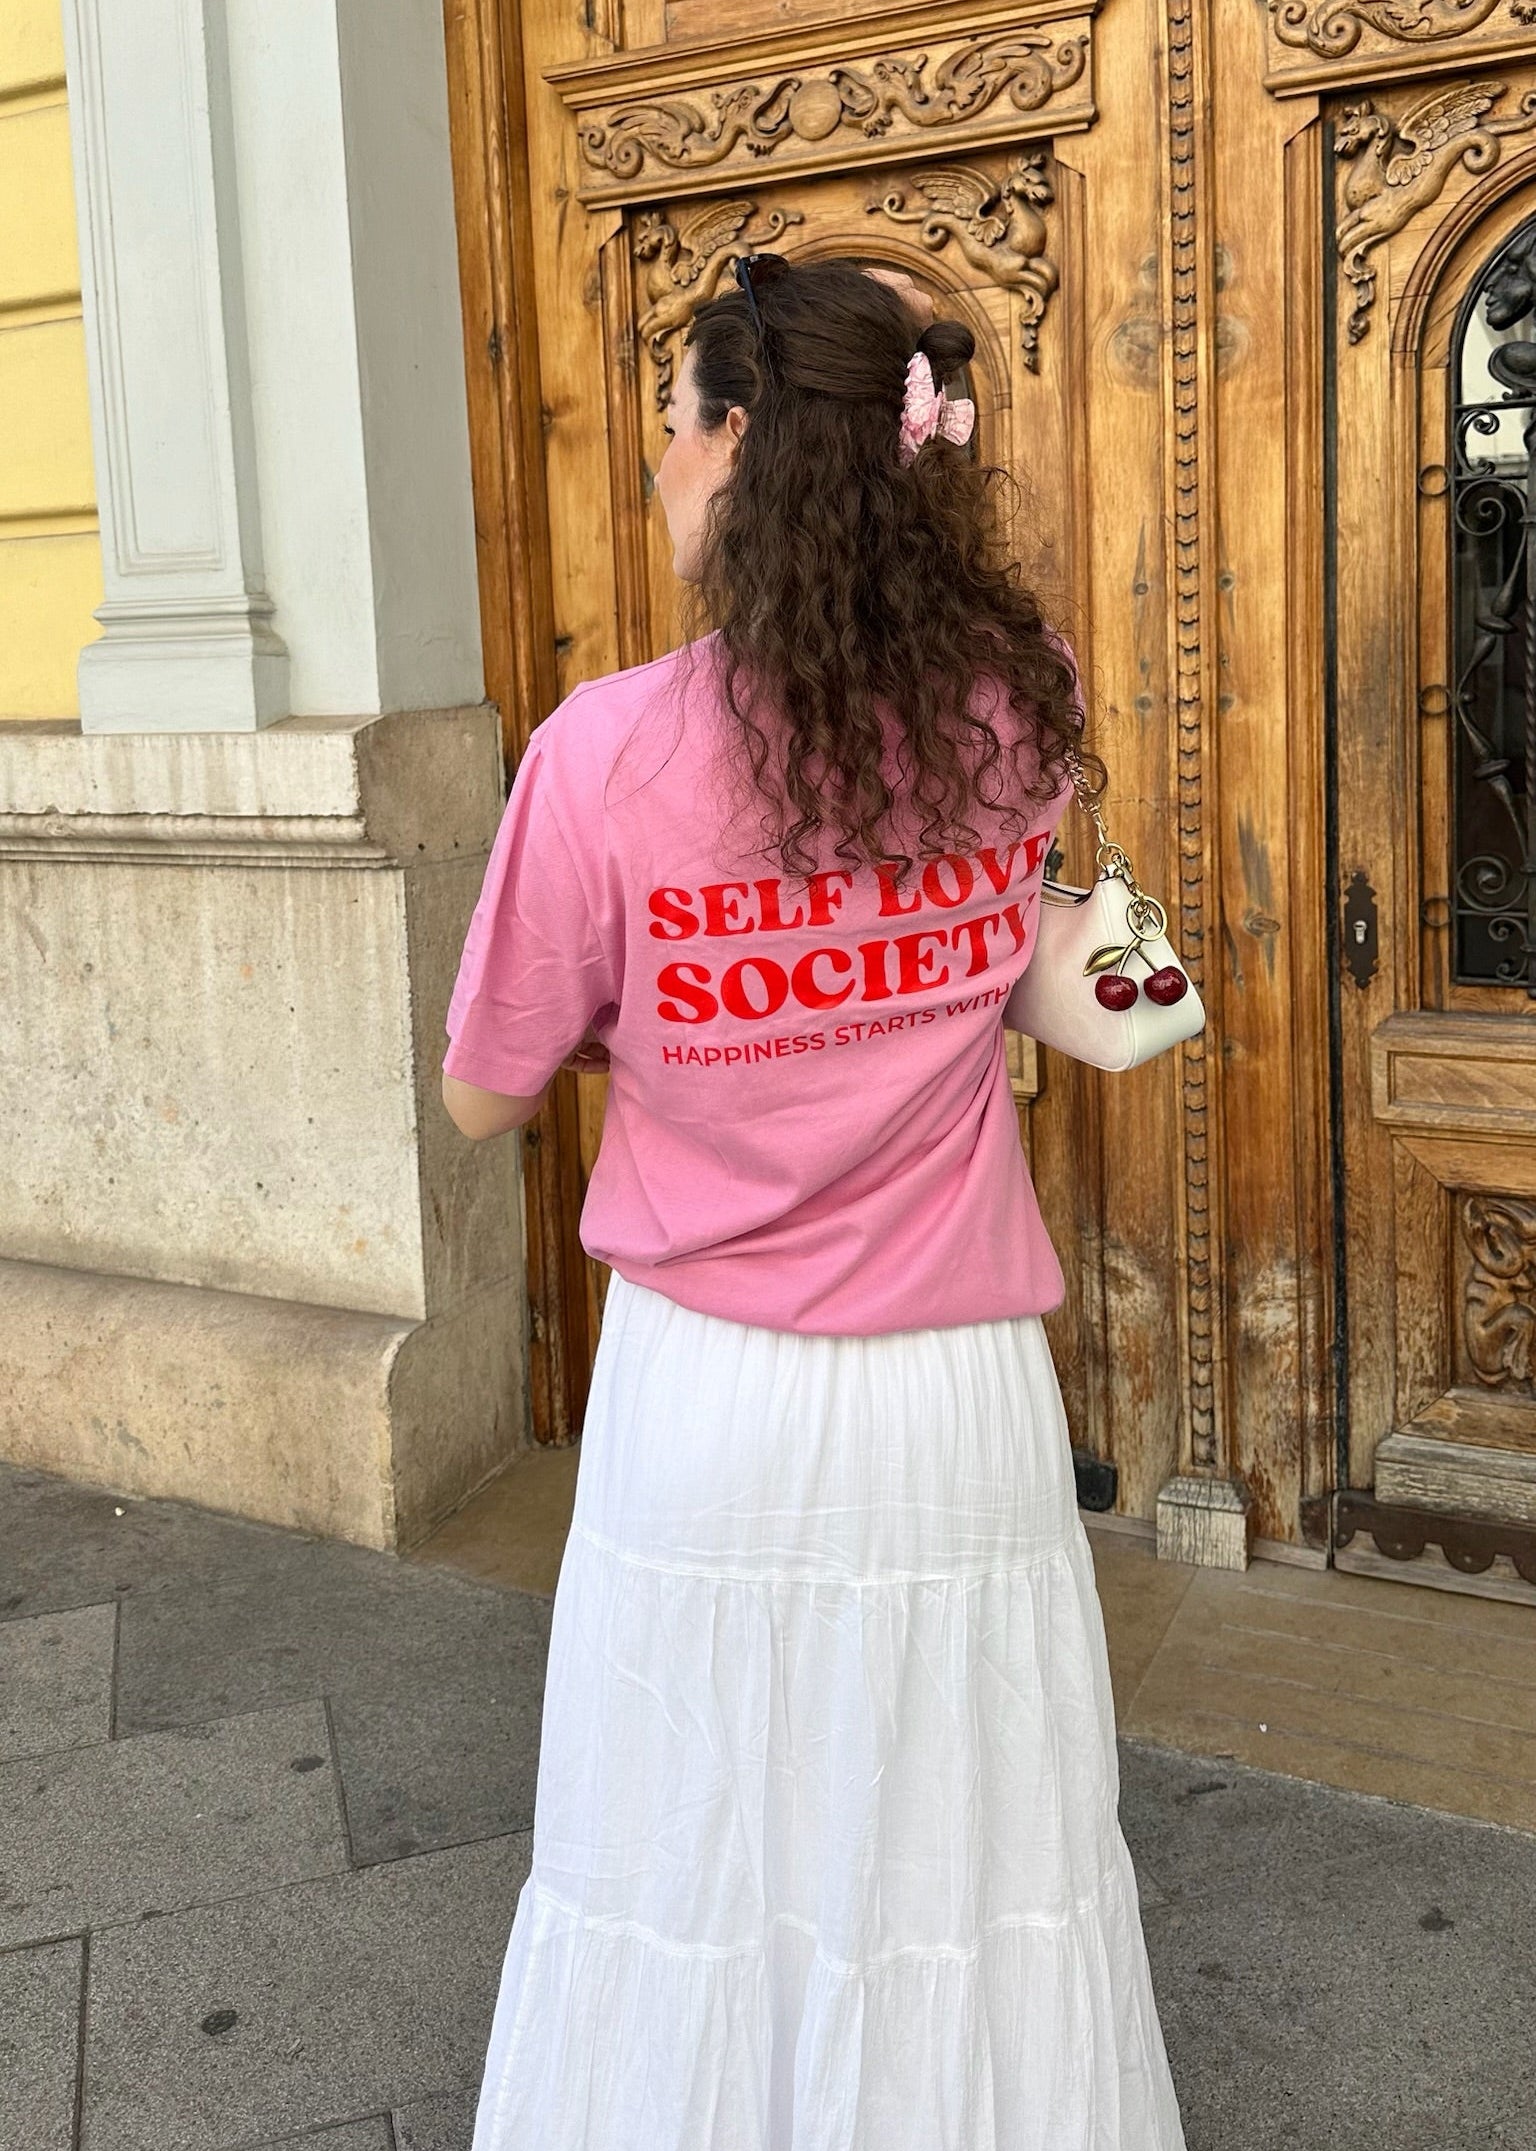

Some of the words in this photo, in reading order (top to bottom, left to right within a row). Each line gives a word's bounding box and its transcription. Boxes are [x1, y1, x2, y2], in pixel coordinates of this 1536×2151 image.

[648, 871, 853, 940] SELF
[874, 830, 1051, 917] LOVE
[656, 892, 1037, 1024] SOCIETY
[662, 1032, 826, 1068] HAPPINESS
[834, 1008, 936, 1046] STARTS
[945, 982, 1010, 1018] WITH
